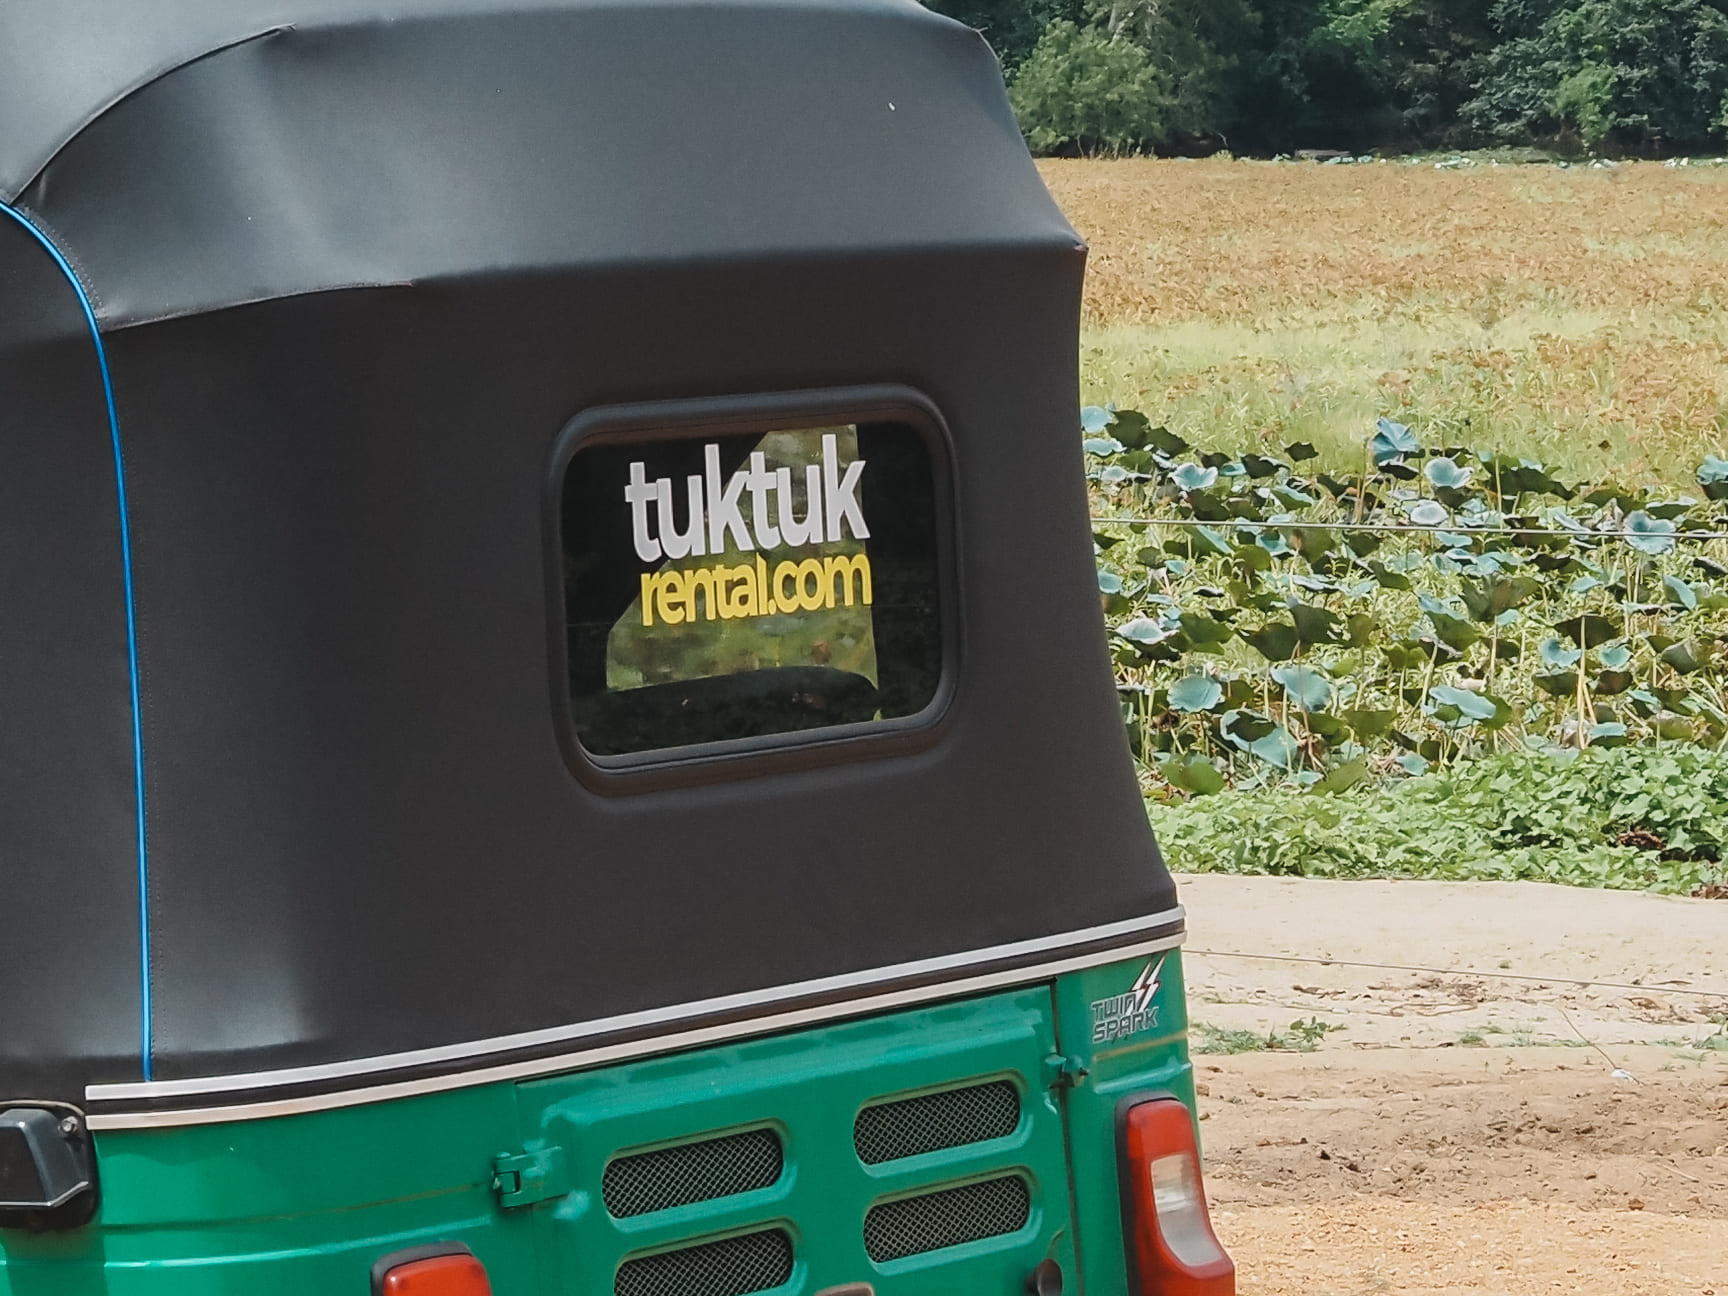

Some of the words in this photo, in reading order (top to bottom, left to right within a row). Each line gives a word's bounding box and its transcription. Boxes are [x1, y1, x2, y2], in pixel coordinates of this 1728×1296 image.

[625, 433, 870, 563] tuktuk
[640, 551, 873, 626] rental.com
[1091, 992, 1136, 1022] TWIN
[1092, 1006, 1159, 1044] SPARK
